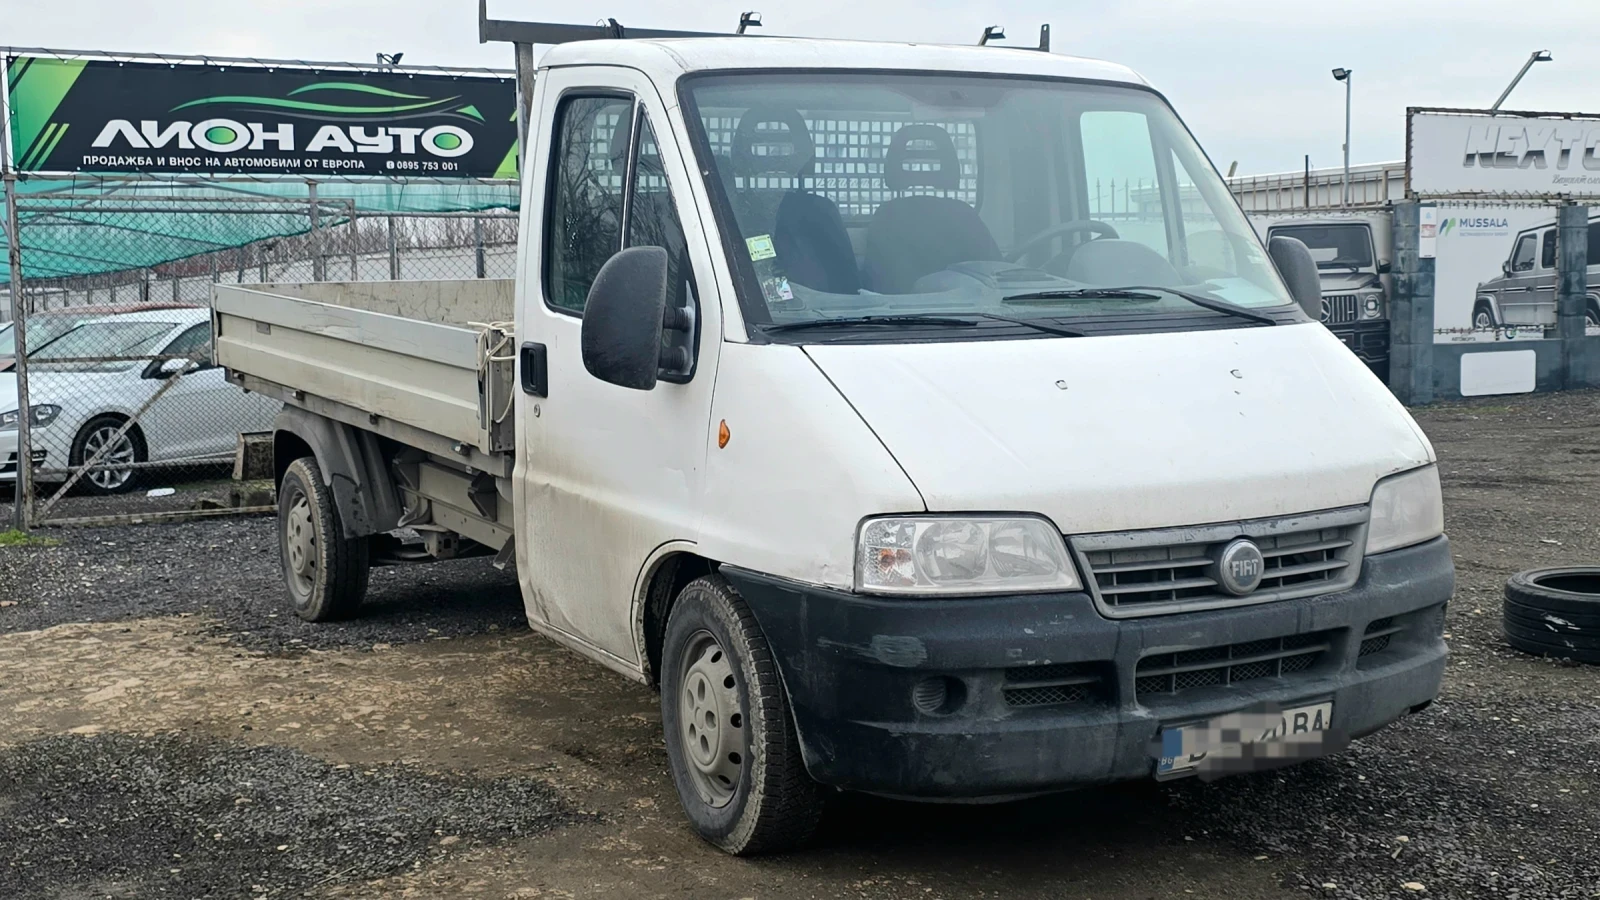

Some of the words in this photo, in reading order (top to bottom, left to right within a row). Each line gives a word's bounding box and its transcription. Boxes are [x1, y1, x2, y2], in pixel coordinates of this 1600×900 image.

[91, 118, 295, 153] ЛИОН
[305, 124, 475, 158] АУТО
[83, 155, 154, 167] ПРОДАЖБА
[157, 156, 166, 167] И
[169, 156, 202, 168] ВНОС
[205, 157, 221, 168] НА
[224, 157, 301, 169] АВТОМОБИЛИ
[304, 158, 319, 169] ОТ
[322, 158, 366, 170] ЕВРОПА
[396, 161, 419, 171] 0895
[422, 161, 439, 171] 753
[442, 162, 459, 171] 001
[1459, 218, 1509, 228] MUSSALA
[1231, 558, 1259, 577] FIAT
